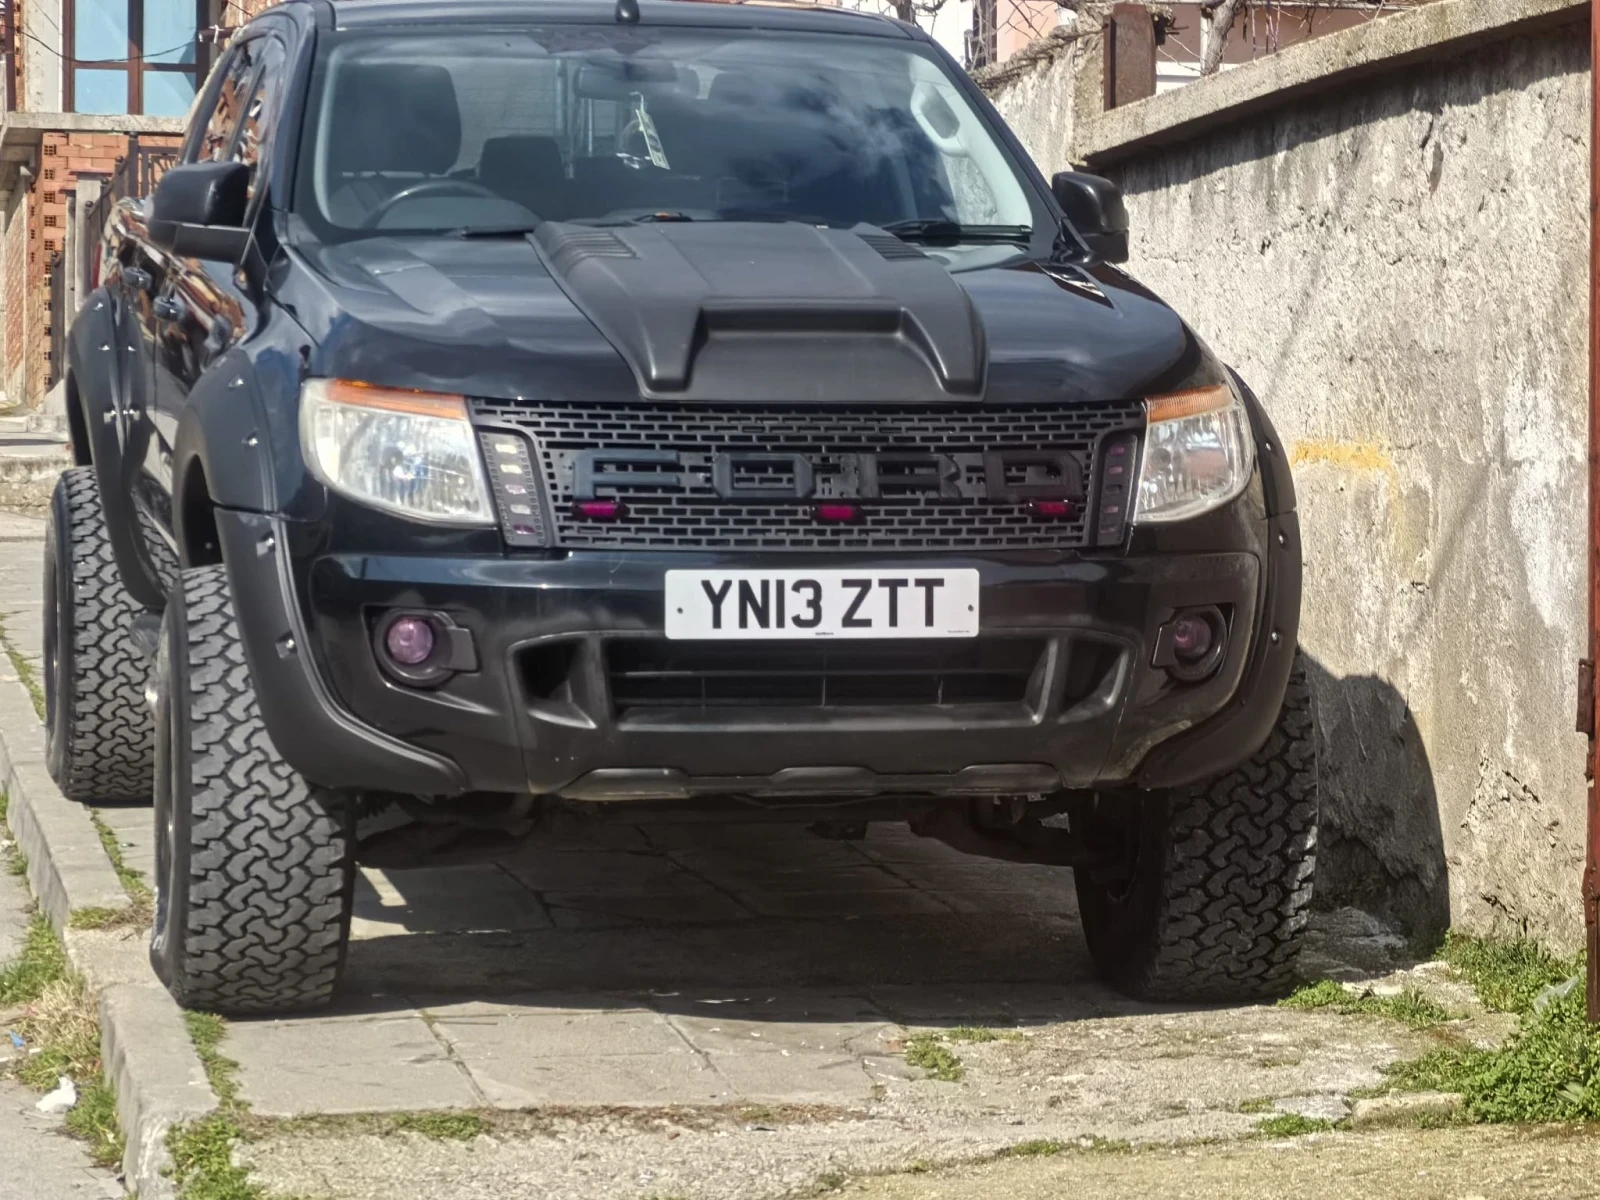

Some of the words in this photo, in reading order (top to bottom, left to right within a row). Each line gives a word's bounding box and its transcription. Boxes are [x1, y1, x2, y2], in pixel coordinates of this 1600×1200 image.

[572, 448, 1084, 501] FORD
[701, 579, 823, 629] YN13
[841, 578, 945, 628] ZTT
